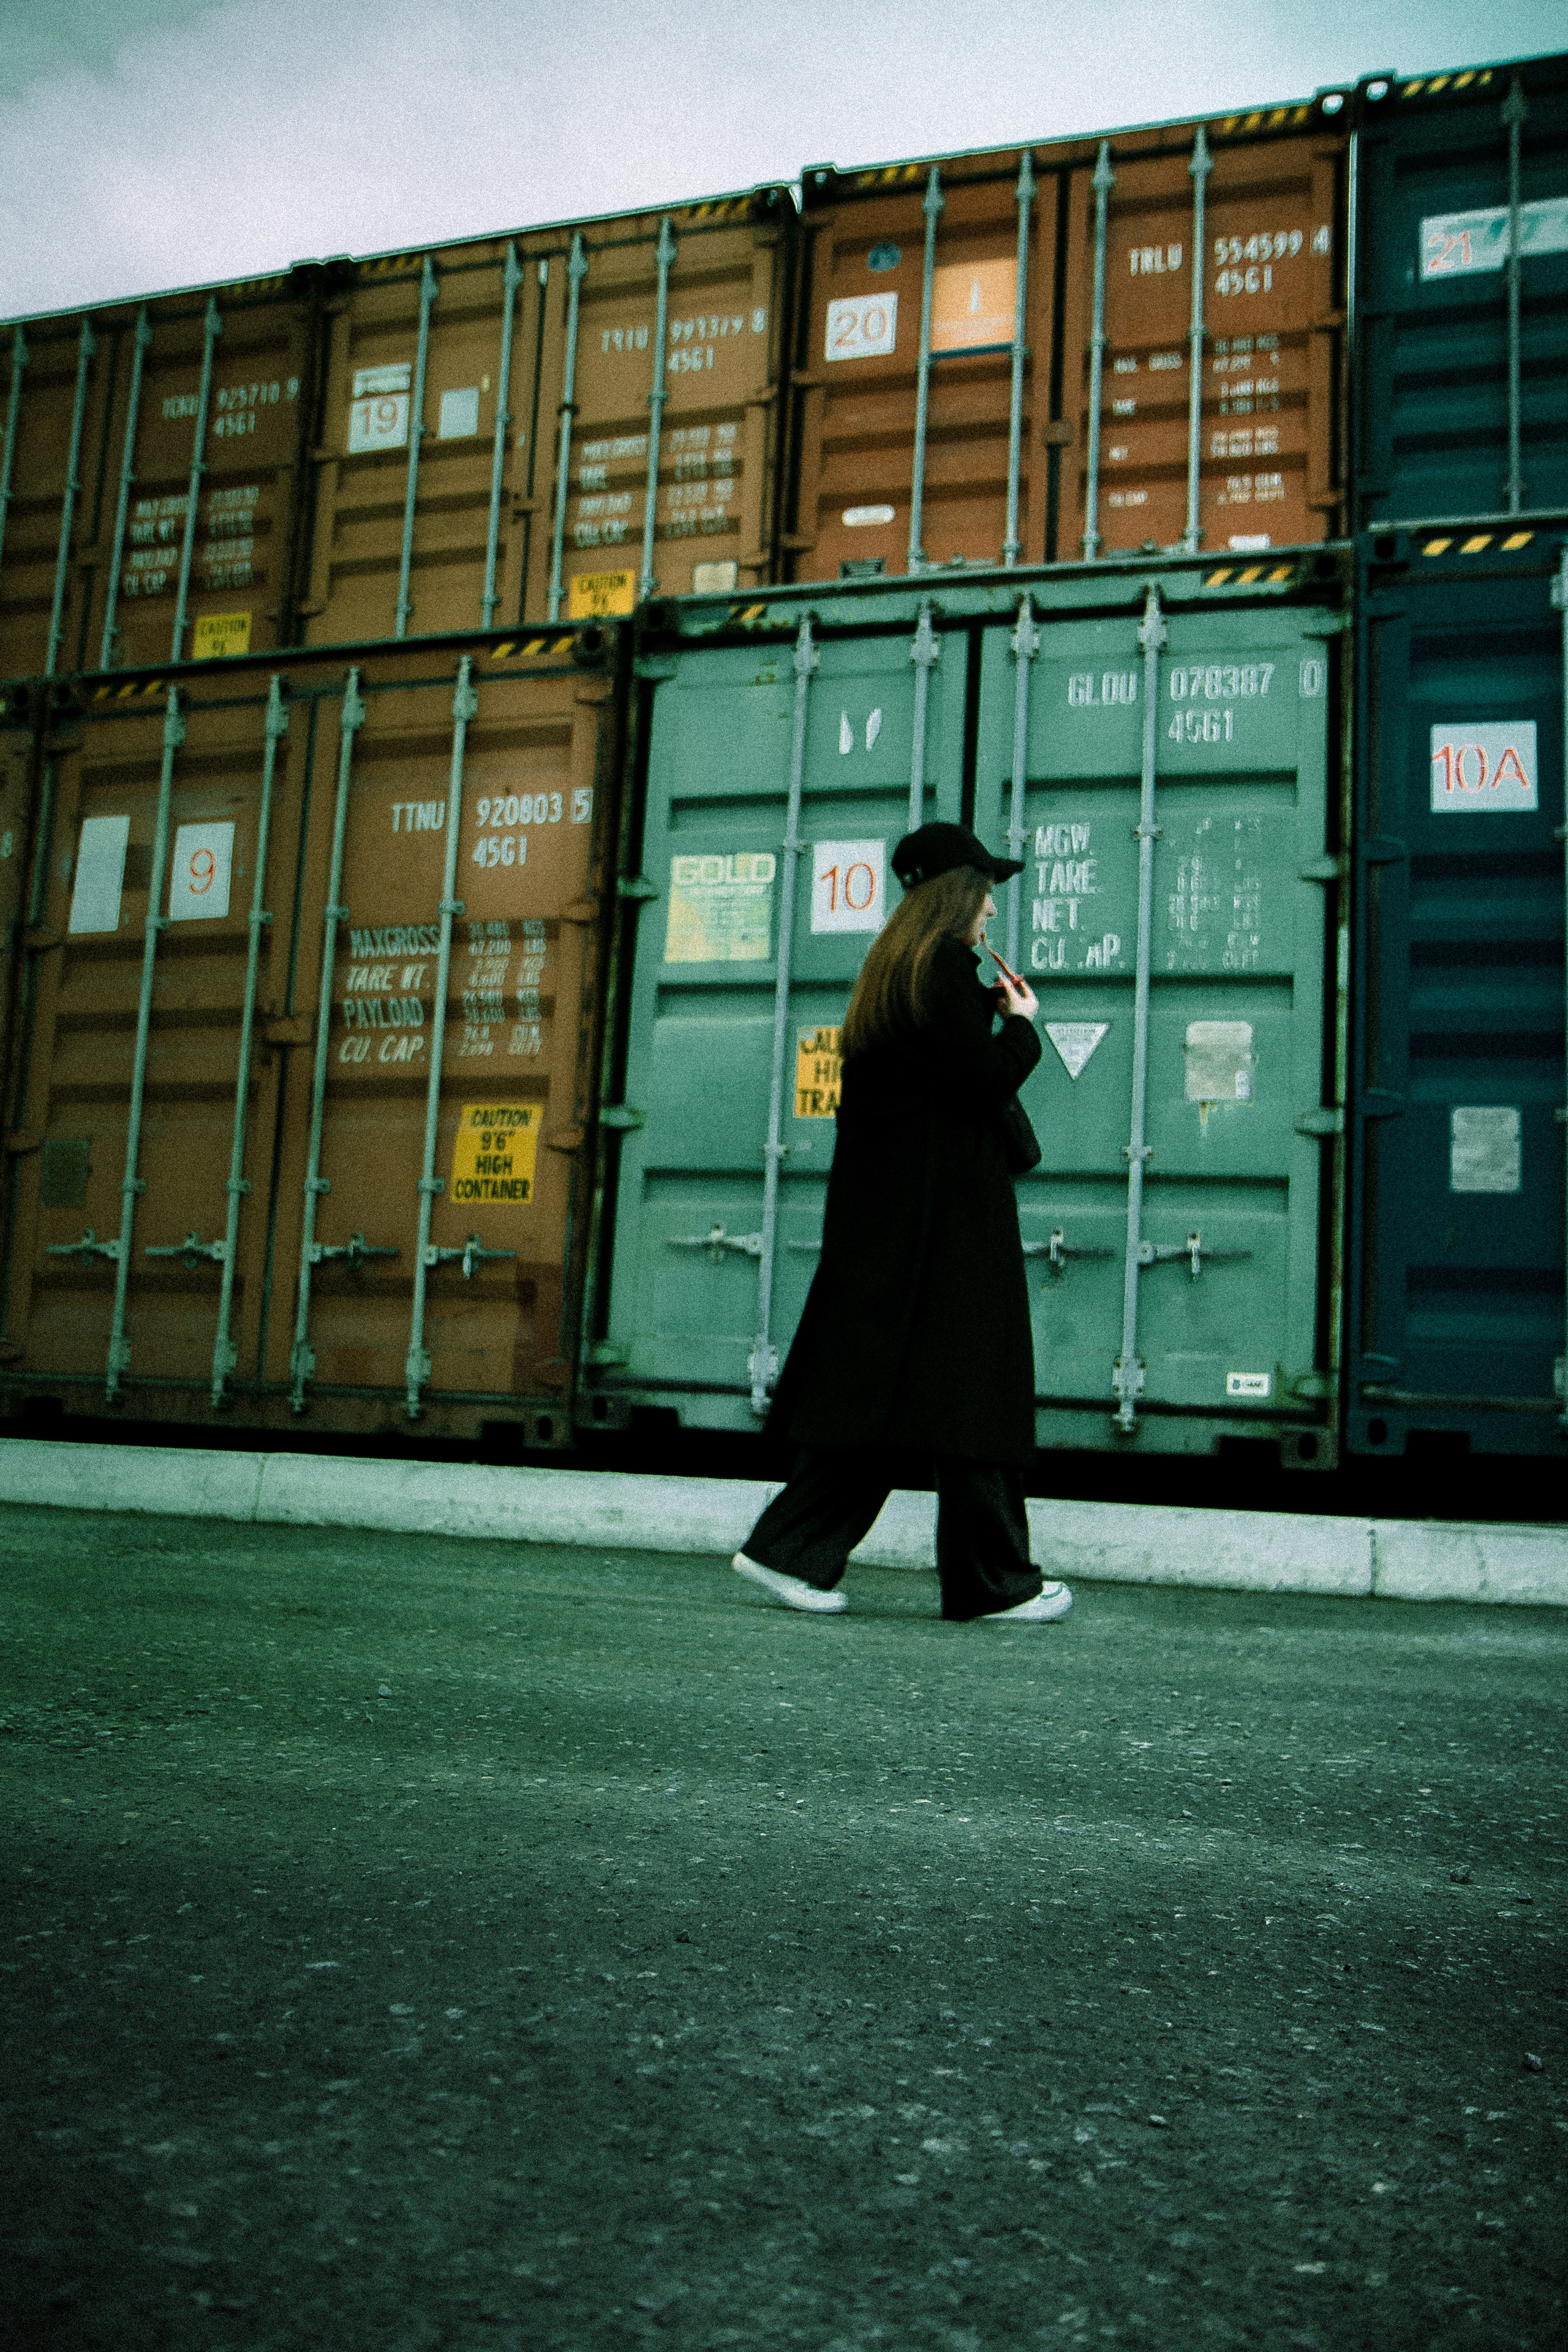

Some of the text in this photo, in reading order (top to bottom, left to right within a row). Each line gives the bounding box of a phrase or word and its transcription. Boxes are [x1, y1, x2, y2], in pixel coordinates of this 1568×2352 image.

[1129, 244, 1183, 277] TRLU
[1214, 230, 1303, 266] 554599
[1428, 230, 1471, 271] 21
[1215, 265, 1273, 296] 45G1
[834, 306, 888, 347] 20
[358, 400, 398, 436] 19
[1170, 663, 1276, 701] 078387
[1168, 709, 1234, 744] 45G1
[1431, 742, 1531, 794] 10A
[391, 788, 592, 833] TTNU 920803 5
[472, 835, 527, 869] 45G1
[189, 848, 215, 894] 9
[820, 862, 876, 913] 10
[1035, 859, 1101, 895] TARE
[345, 964, 396, 992] TARE
[342, 997, 424, 1030] PAYLOAD
[471, 1109, 533, 1127] CAUTION
[475, 1155, 514, 1175] HIGH
[455, 1178, 530, 1199] CONTAINER
